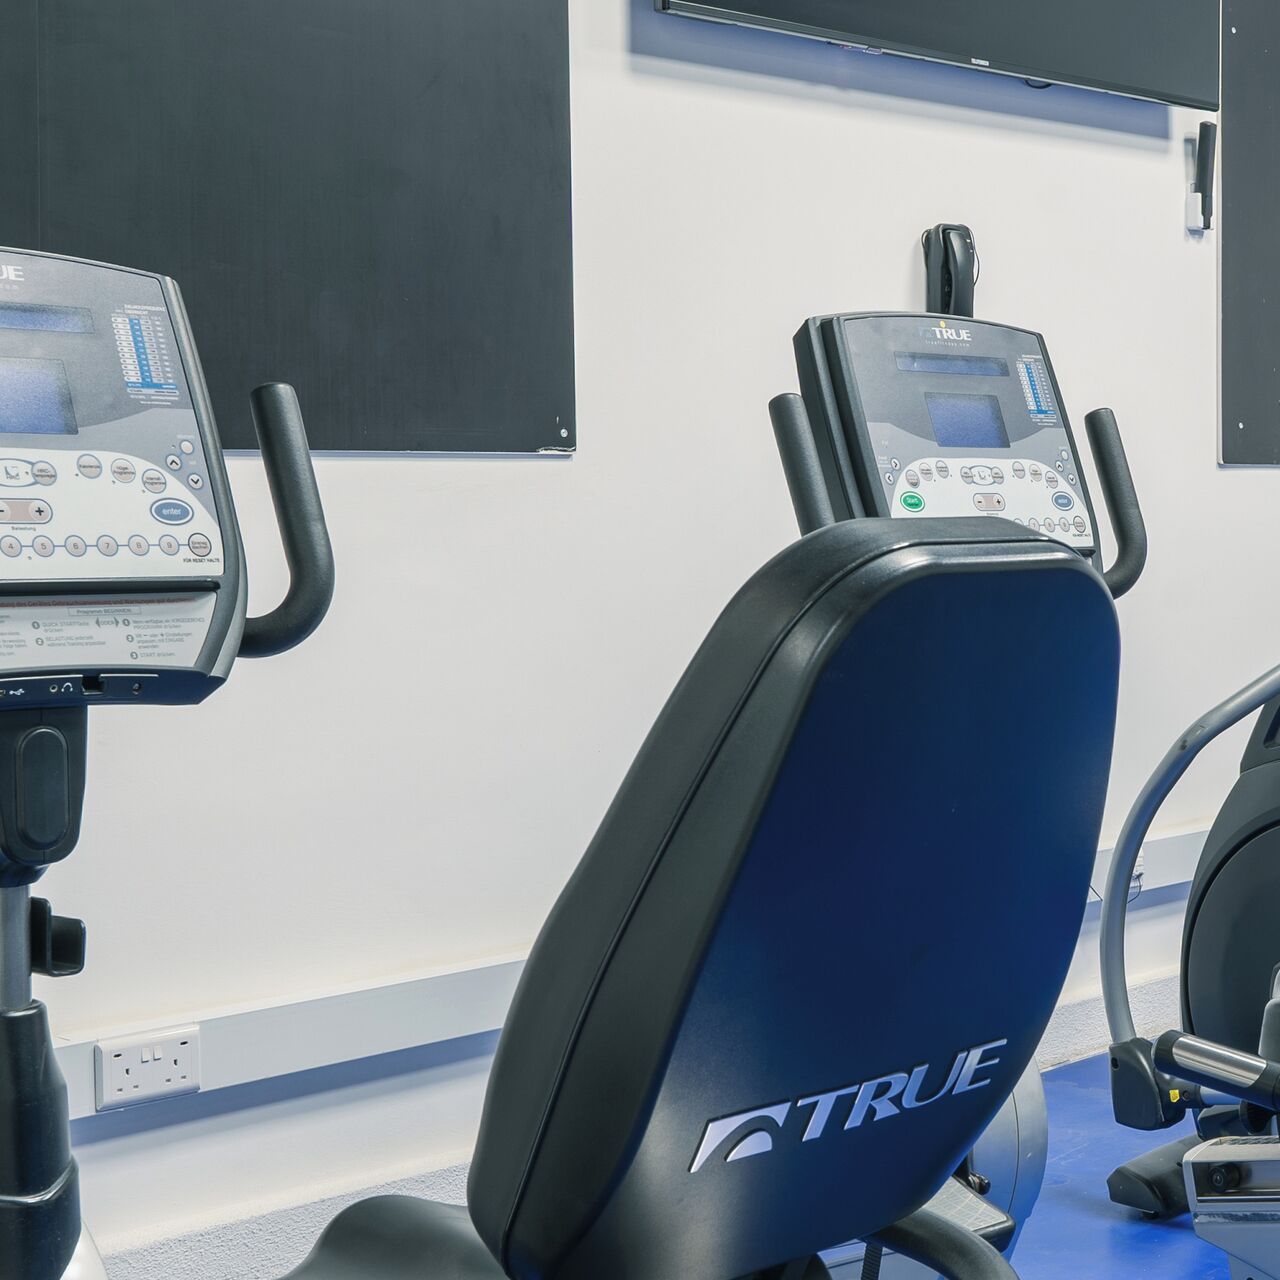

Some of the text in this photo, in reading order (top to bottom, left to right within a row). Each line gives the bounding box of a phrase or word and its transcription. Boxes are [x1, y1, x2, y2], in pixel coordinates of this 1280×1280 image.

[931, 327, 972, 340] TRUE
[162, 507, 181, 515] enter
[796, 1038, 1008, 1143] TRUE
